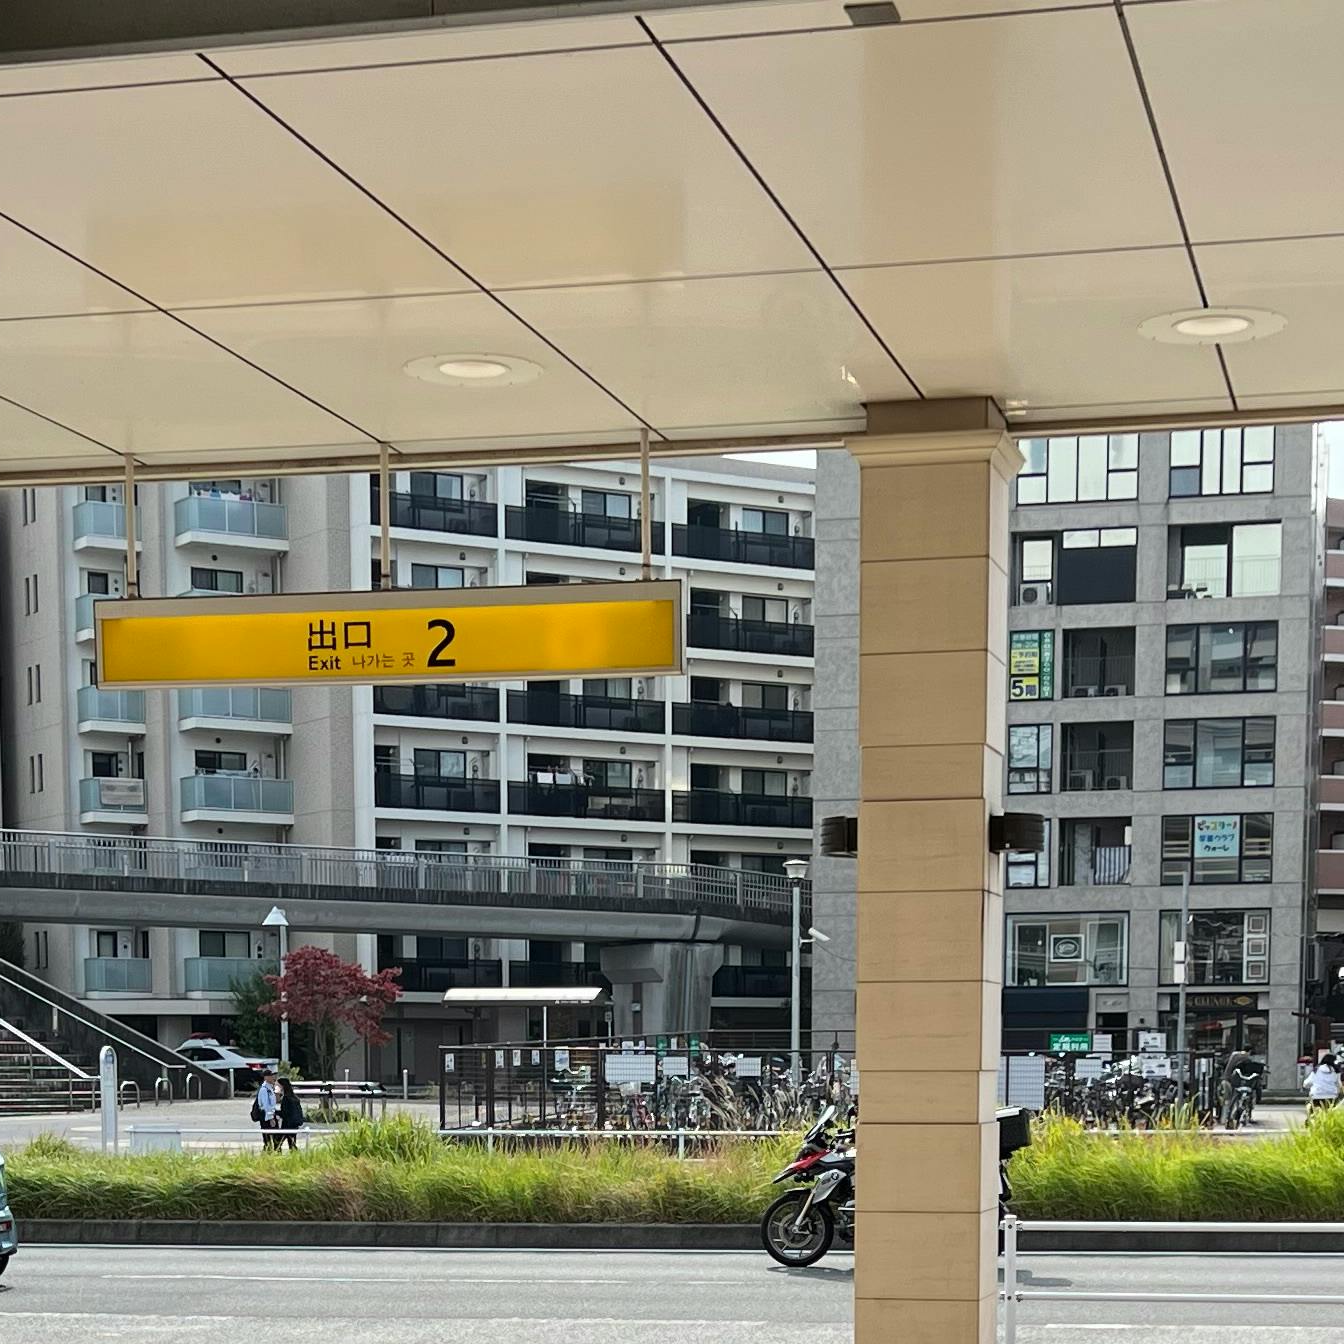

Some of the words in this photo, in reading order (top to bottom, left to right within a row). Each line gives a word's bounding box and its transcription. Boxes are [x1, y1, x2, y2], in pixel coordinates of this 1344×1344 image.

[307, 619, 372, 652] 出口
[427, 618, 457, 668] 2
[308, 655, 342, 671] Exit
[352, 652, 396, 669] 나가는
[401, 652, 416, 668] 곳
